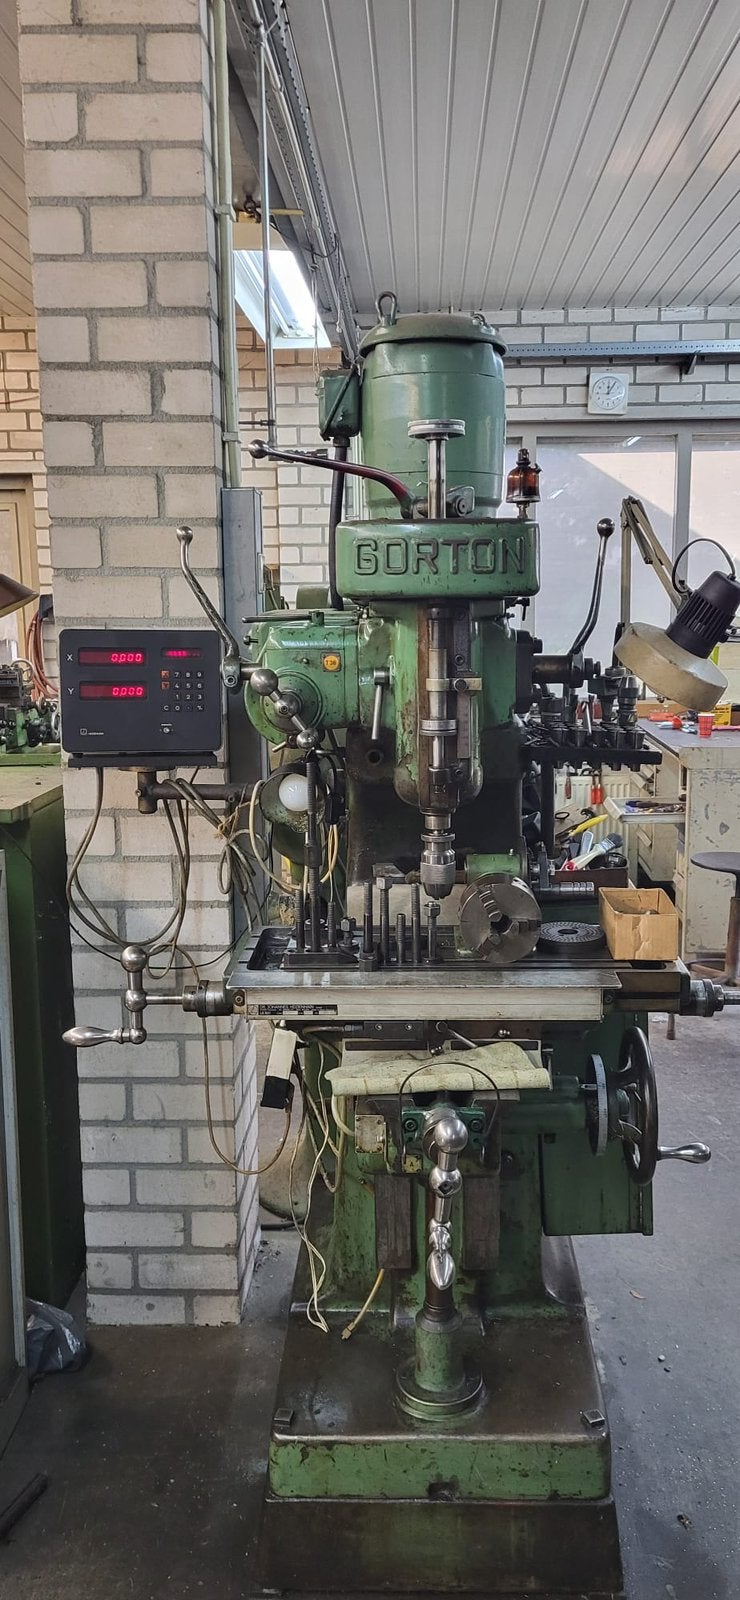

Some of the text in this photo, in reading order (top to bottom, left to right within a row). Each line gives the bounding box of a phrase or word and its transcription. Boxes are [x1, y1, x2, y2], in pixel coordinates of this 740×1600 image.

[353, 537, 525, 575] GORTON
[66, 653, 73, 661] X
[67, 687, 74, 695] Y
